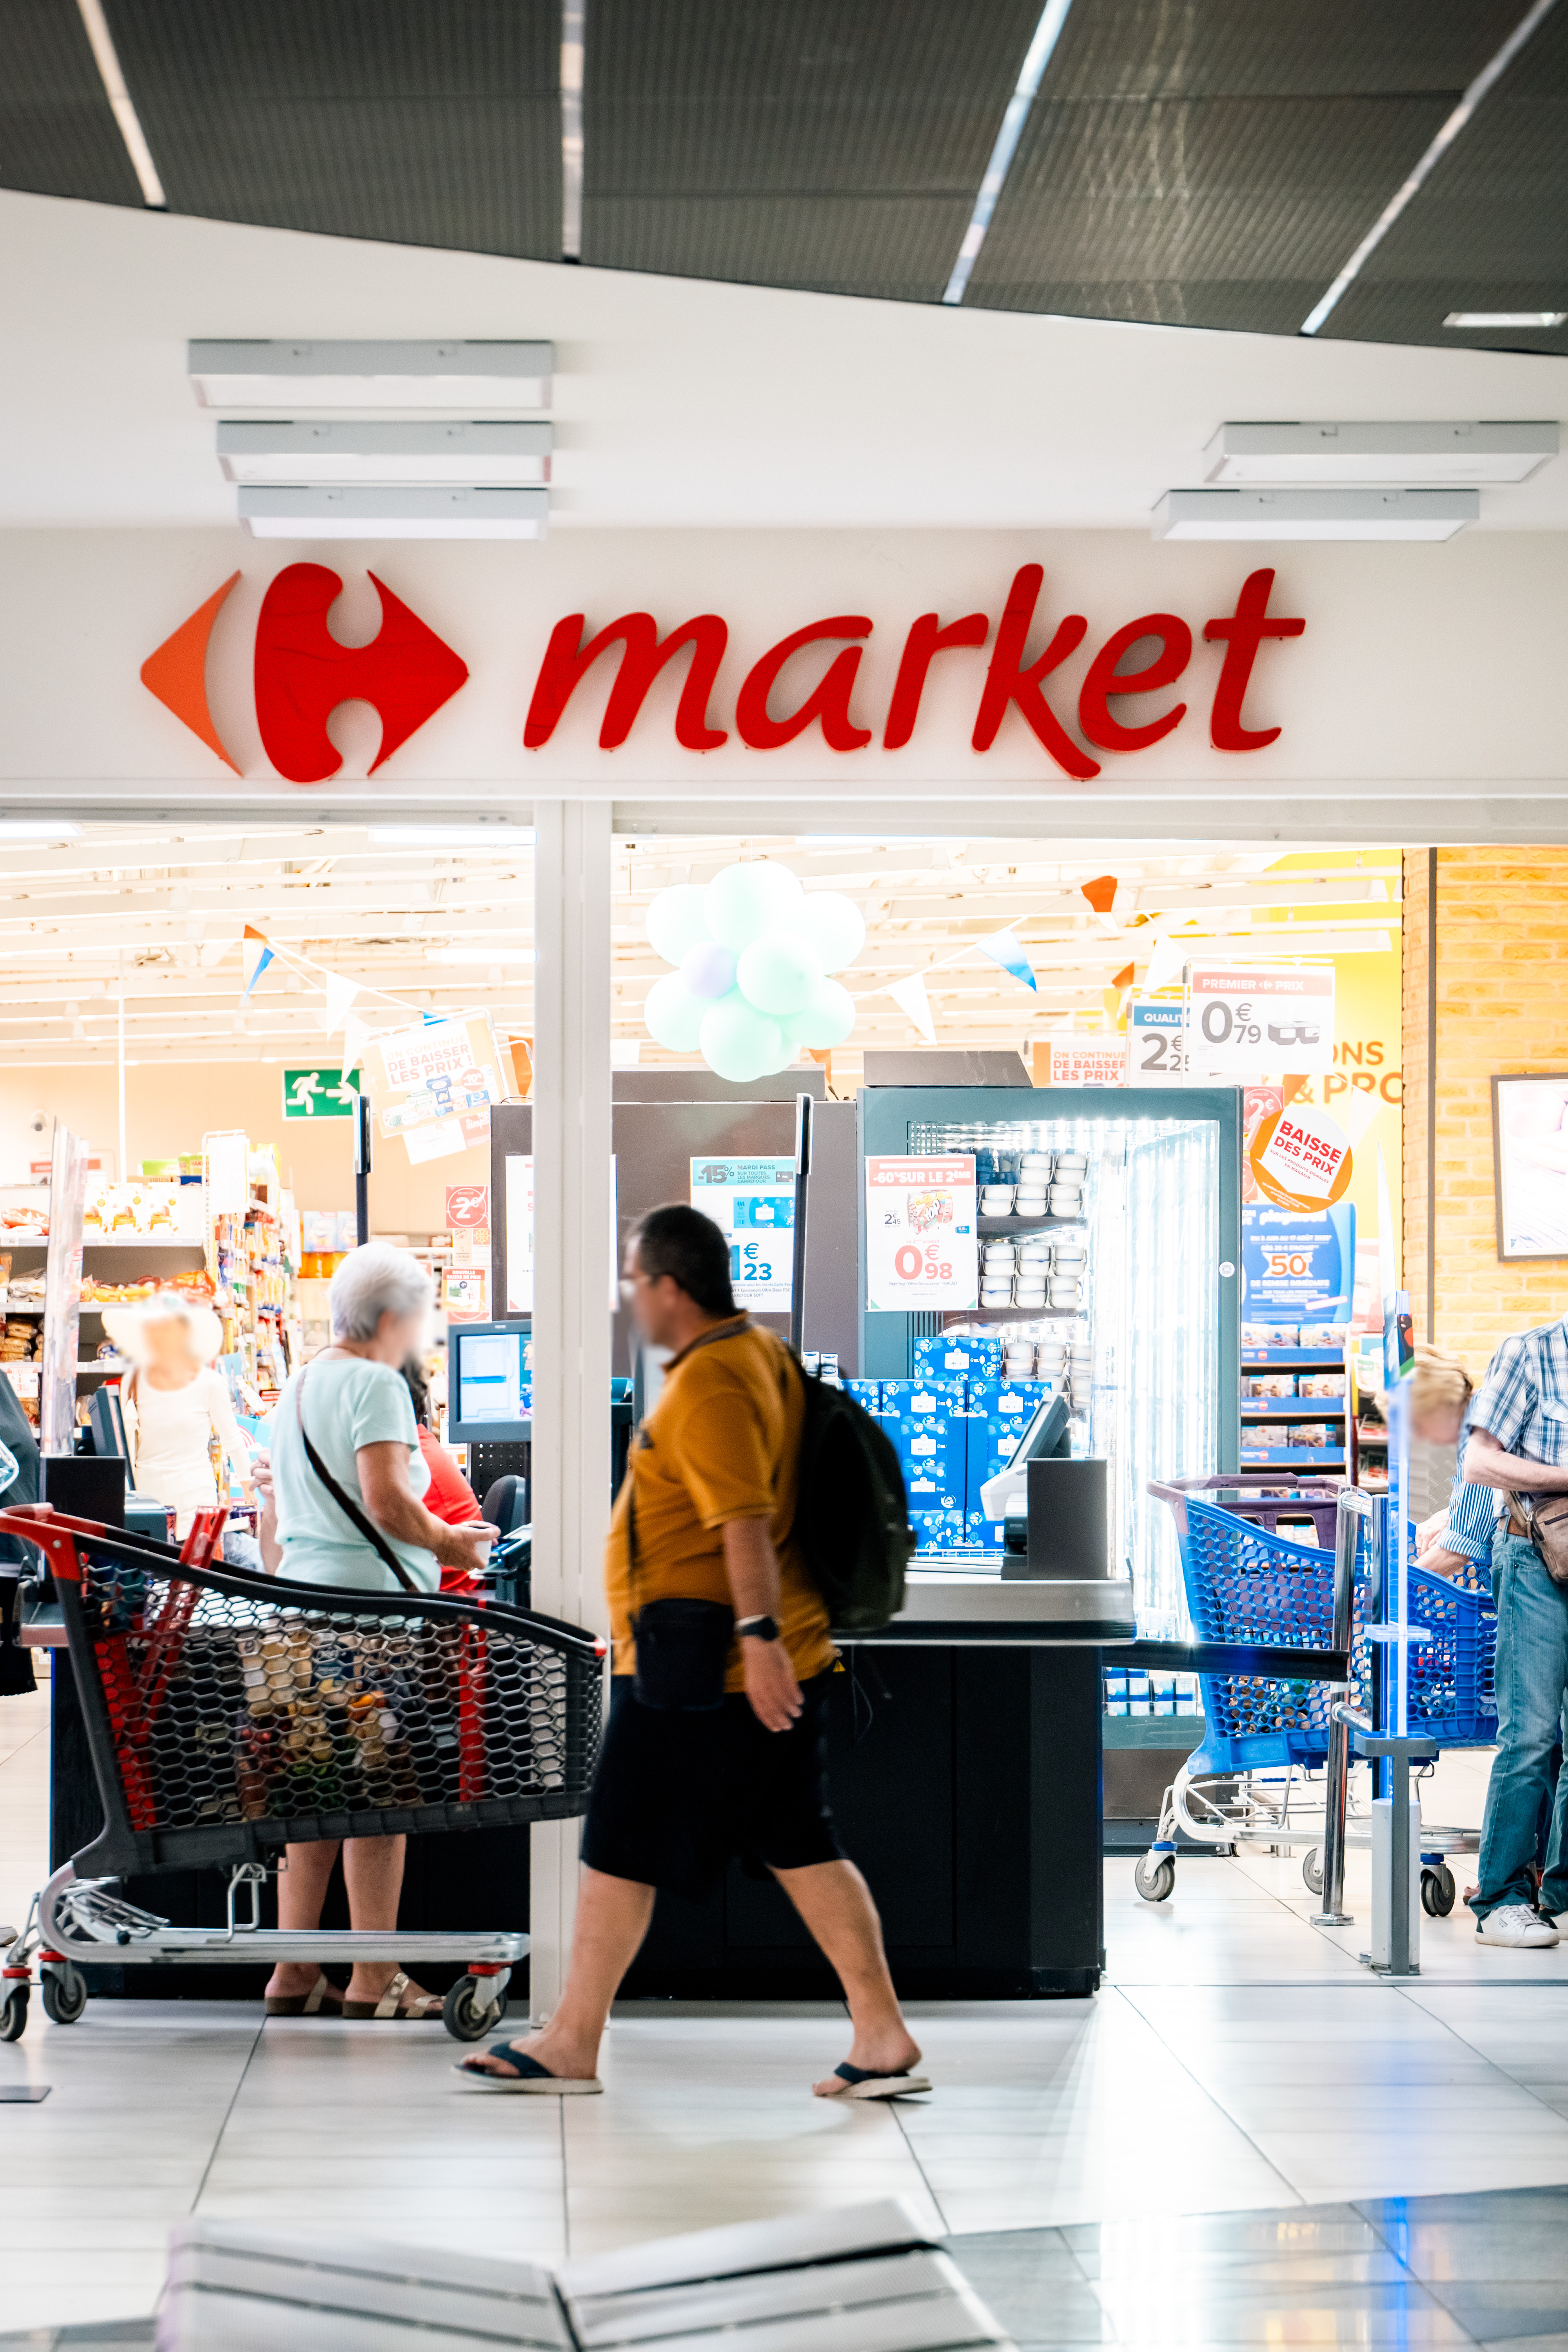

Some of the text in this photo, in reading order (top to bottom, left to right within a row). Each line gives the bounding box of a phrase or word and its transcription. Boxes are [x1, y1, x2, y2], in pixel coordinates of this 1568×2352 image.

[523, 563, 1306, 779] market
[1203, 979, 1304, 991] PREMIER PRIX
[386, 1034, 466, 1060] ON CONTINUE
[388, 1044, 468, 1072] DE BAISSER
[1054, 1060, 1125, 1069] DE BAISSER
[390, 1068, 420, 1085] LES
[424, 1057, 464, 1076] PRIX
[1054, 1070, 1119, 1080] LES PRIX
[1279, 1120, 1342, 1163] BAISSE
[1274, 1136, 1335, 1176] DES PRIX
[1287, 1158, 1308, 1172] PRODUITS
[699, 1165, 734, 1183] -15%
[899, 1171, 926, 1183] SUR
[929, 1171, 943, 1183] LE
[1291, 1167, 1310, 1179] MAGASIN
[923, 1198, 940, 1222] YOP
